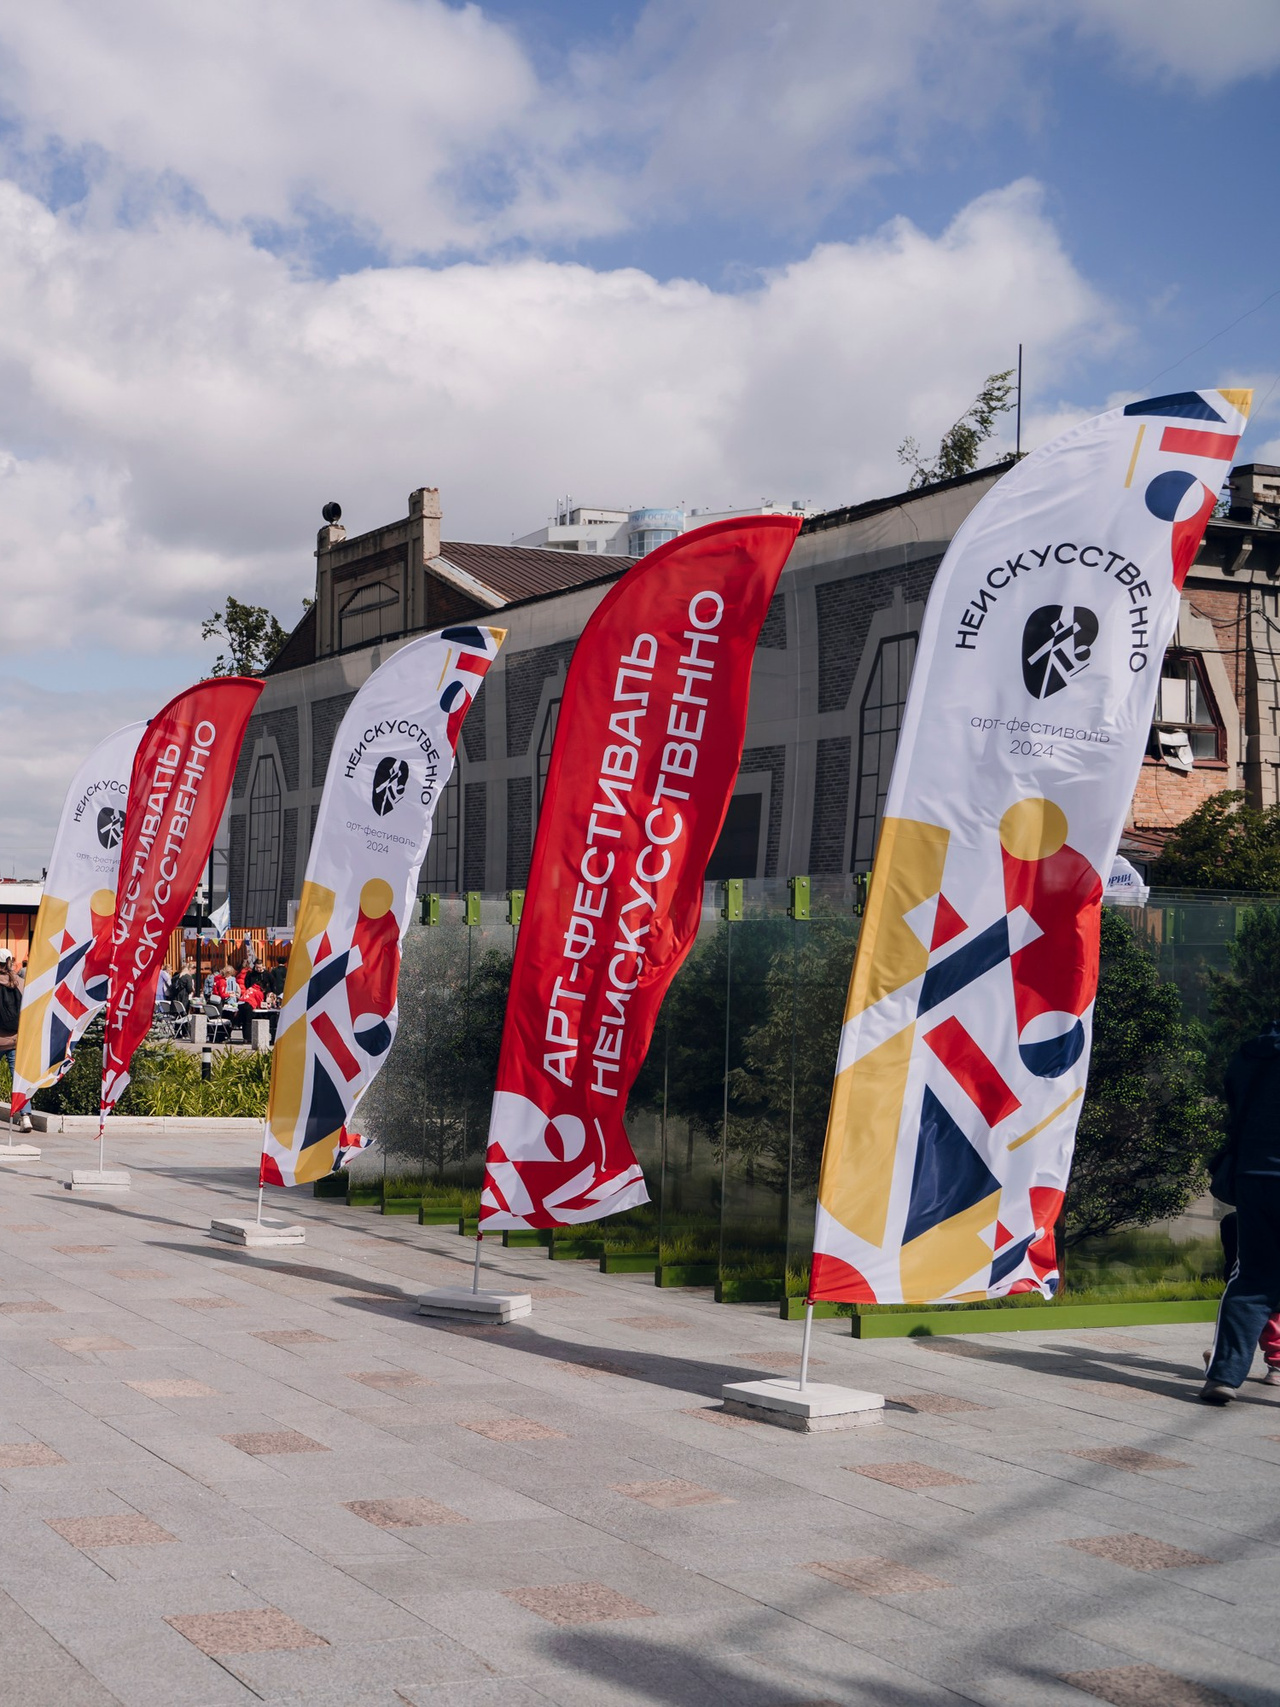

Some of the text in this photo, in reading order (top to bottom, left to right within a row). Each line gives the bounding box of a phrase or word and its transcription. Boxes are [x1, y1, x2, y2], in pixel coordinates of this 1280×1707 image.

[955, 543, 1152, 673] НЕИСКУССТВЕННО
[970, 716, 1110, 743] арт-фестиваль
[344, 719, 440, 805] НЕИСКУССТВЕННО
[1009, 739, 1054, 758] 2024
[346, 820, 416, 848] арт-фестиваль
[366, 840, 389, 854] 2024
[590, 590, 724, 1097] НЕИСКУССТВЕННО
[95, 865, 115, 873] 2024
[543, 632, 658, 1087] АРТ-ФЕСТИВАЛЬ
